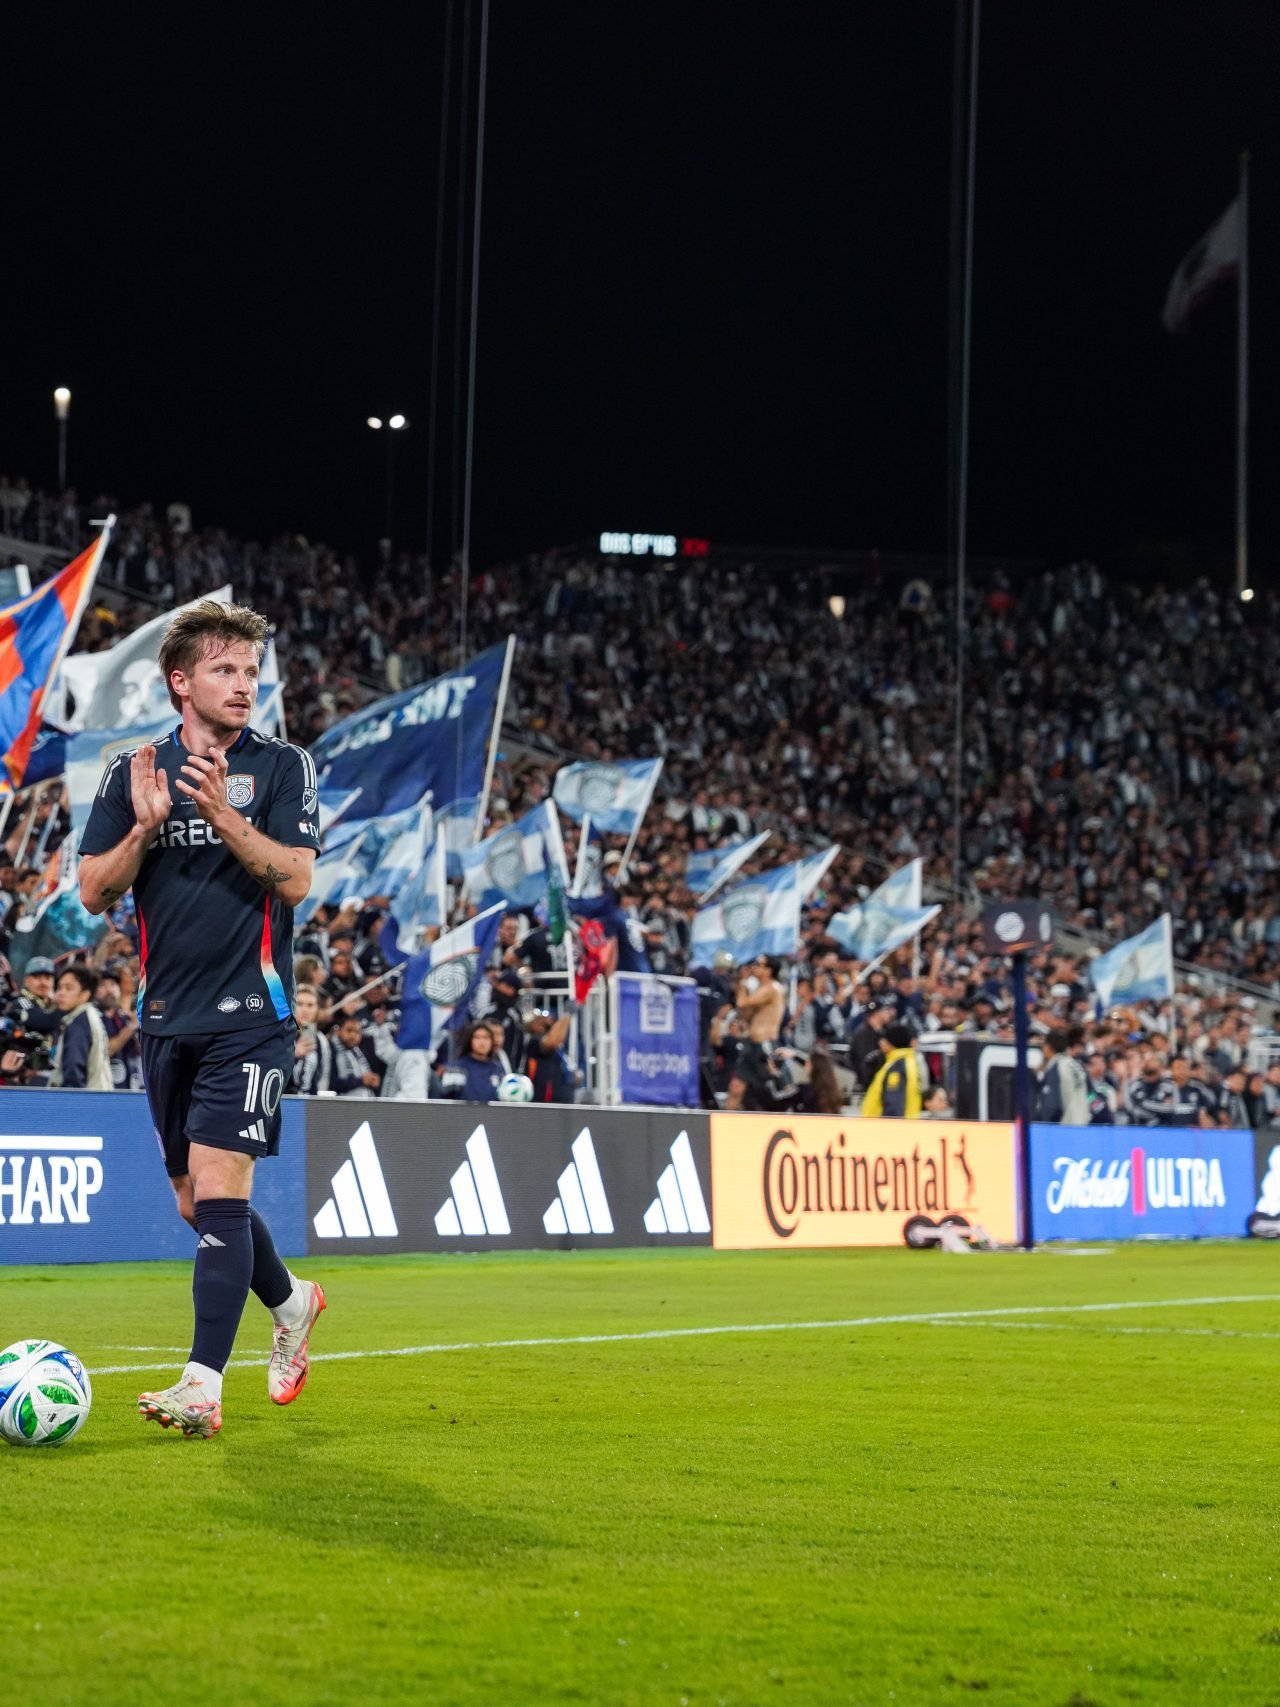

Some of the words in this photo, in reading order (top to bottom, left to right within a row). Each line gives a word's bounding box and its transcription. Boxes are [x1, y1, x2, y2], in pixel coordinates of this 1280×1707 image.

[242, 1063, 285, 1117] 10
[763, 1129, 951, 1238] Continental
[1146, 1157, 1226, 1209] ULTRA
